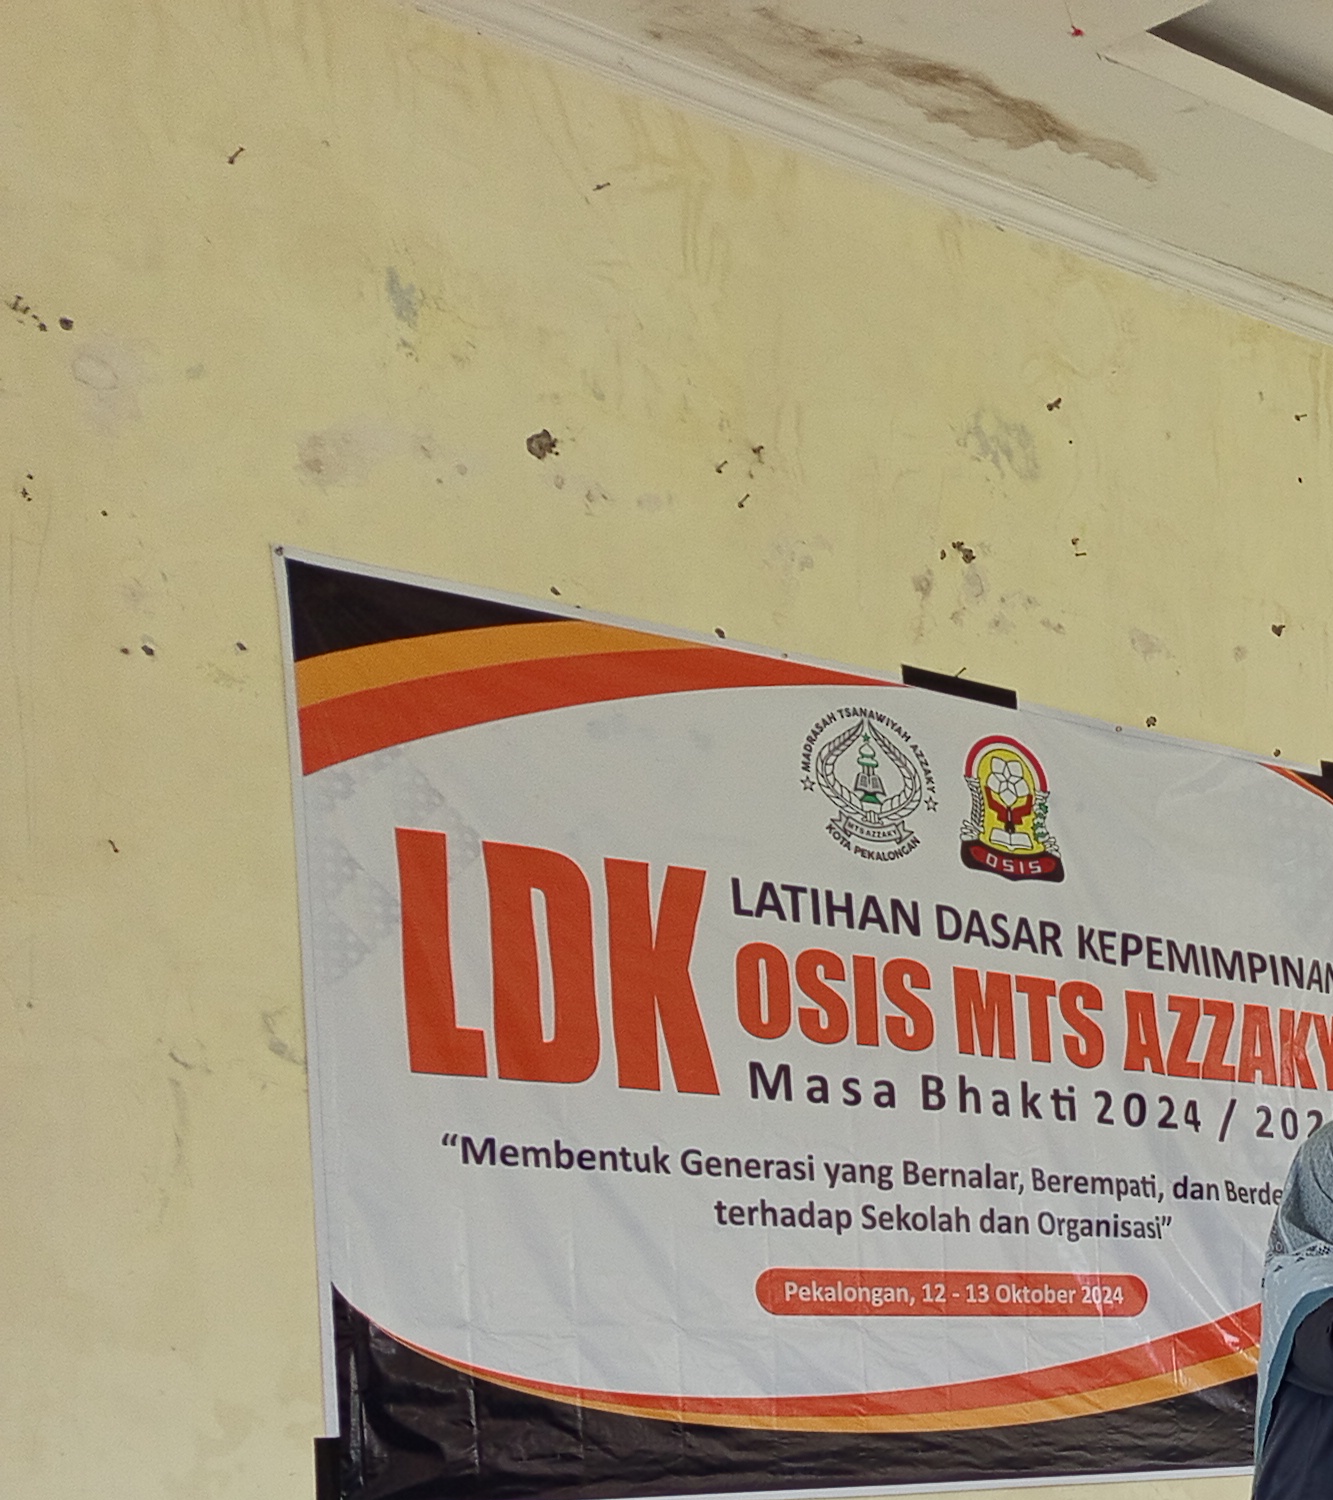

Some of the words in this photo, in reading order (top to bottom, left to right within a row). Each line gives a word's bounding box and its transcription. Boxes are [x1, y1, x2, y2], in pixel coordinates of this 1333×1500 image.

[801, 712, 838, 773] MADRASAH
[836, 706, 912, 743] TSANAWIYAH
[909, 744, 937, 794] AZZAKY
[825, 823, 851, 851] KOTA
[853, 836, 921, 862] PEKALONGAN
[985, 852, 1042, 874] OSIS
[731, 877, 921, 937] LATIHAN
[935, 903, 1063, 958] DASAR
[394, 827, 721, 1096] LDK
[735, 941, 935, 1052] OSIS
[952, 966, 1105, 1070] MTS
[748, 1061, 896, 1109] Masa
[921, 1074, 1077, 1122] Bhakti
[1094, 1090, 1201, 1133] 2024
[1218, 1098, 1237, 1142] /
[441, 1132, 671, 1175] “Membentuk
[680, 1148, 815, 1182] Generasi
[823, 1162, 894, 1191] yang
[902, 1160, 1024, 1196] Bernalar,
[1031, 1167, 1164, 1204] Berempati,
[1172, 1175, 1220, 1201] dan
[1224, 1179, 1284, 1206] Berde
[713, 1198, 853, 1236] terhadap
[861, 1203, 971, 1233] Sekolah
[979, 1207, 1030, 1235] dan
[1037, 1211, 1172, 1243] Organisasi”
[784, 1281, 916, 1308] Pekalongan,
[921, 1283, 947, 1303] 12
[965, 1283, 990, 1304] 13
[995, 1284, 1077, 1304] Oktober
[1081, 1286, 1124, 1305] 2024
